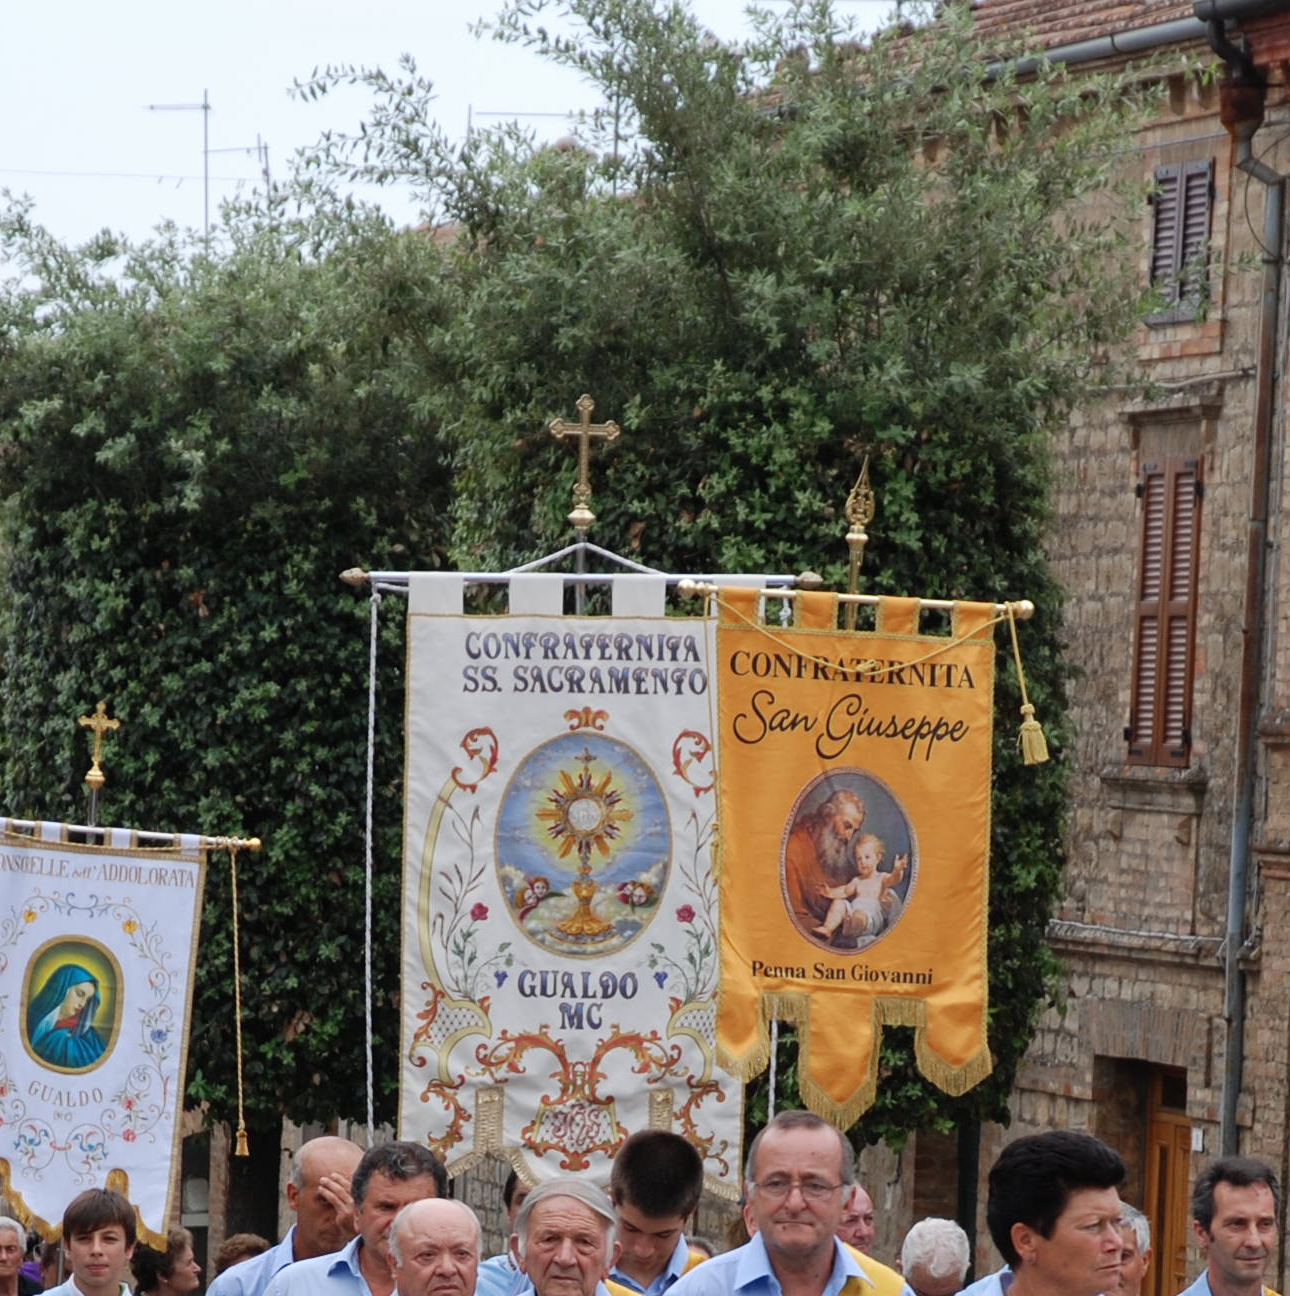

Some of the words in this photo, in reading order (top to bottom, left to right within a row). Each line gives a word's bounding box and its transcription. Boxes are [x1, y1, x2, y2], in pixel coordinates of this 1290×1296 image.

[465, 631, 701, 662] CONFRATERNITA
[462, 665, 503, 693] SS.
[513, 665, 708, 695] SACRAMENTO
[729, 650, 975, 689] CONFRATERNITA
[732, 690, 817, 745] San
[815, 694, 969, 761] Giuseppe
[517, 969, 639, 1000] GUALDO
[751, 960, 806, 979] Penna
[812, 962, 846, 981] San
[851, 964, 934, 985] Giovanni
[559, 1002, 603, 1030] MC
[28, 1080, 104, 1108] GUALDO
